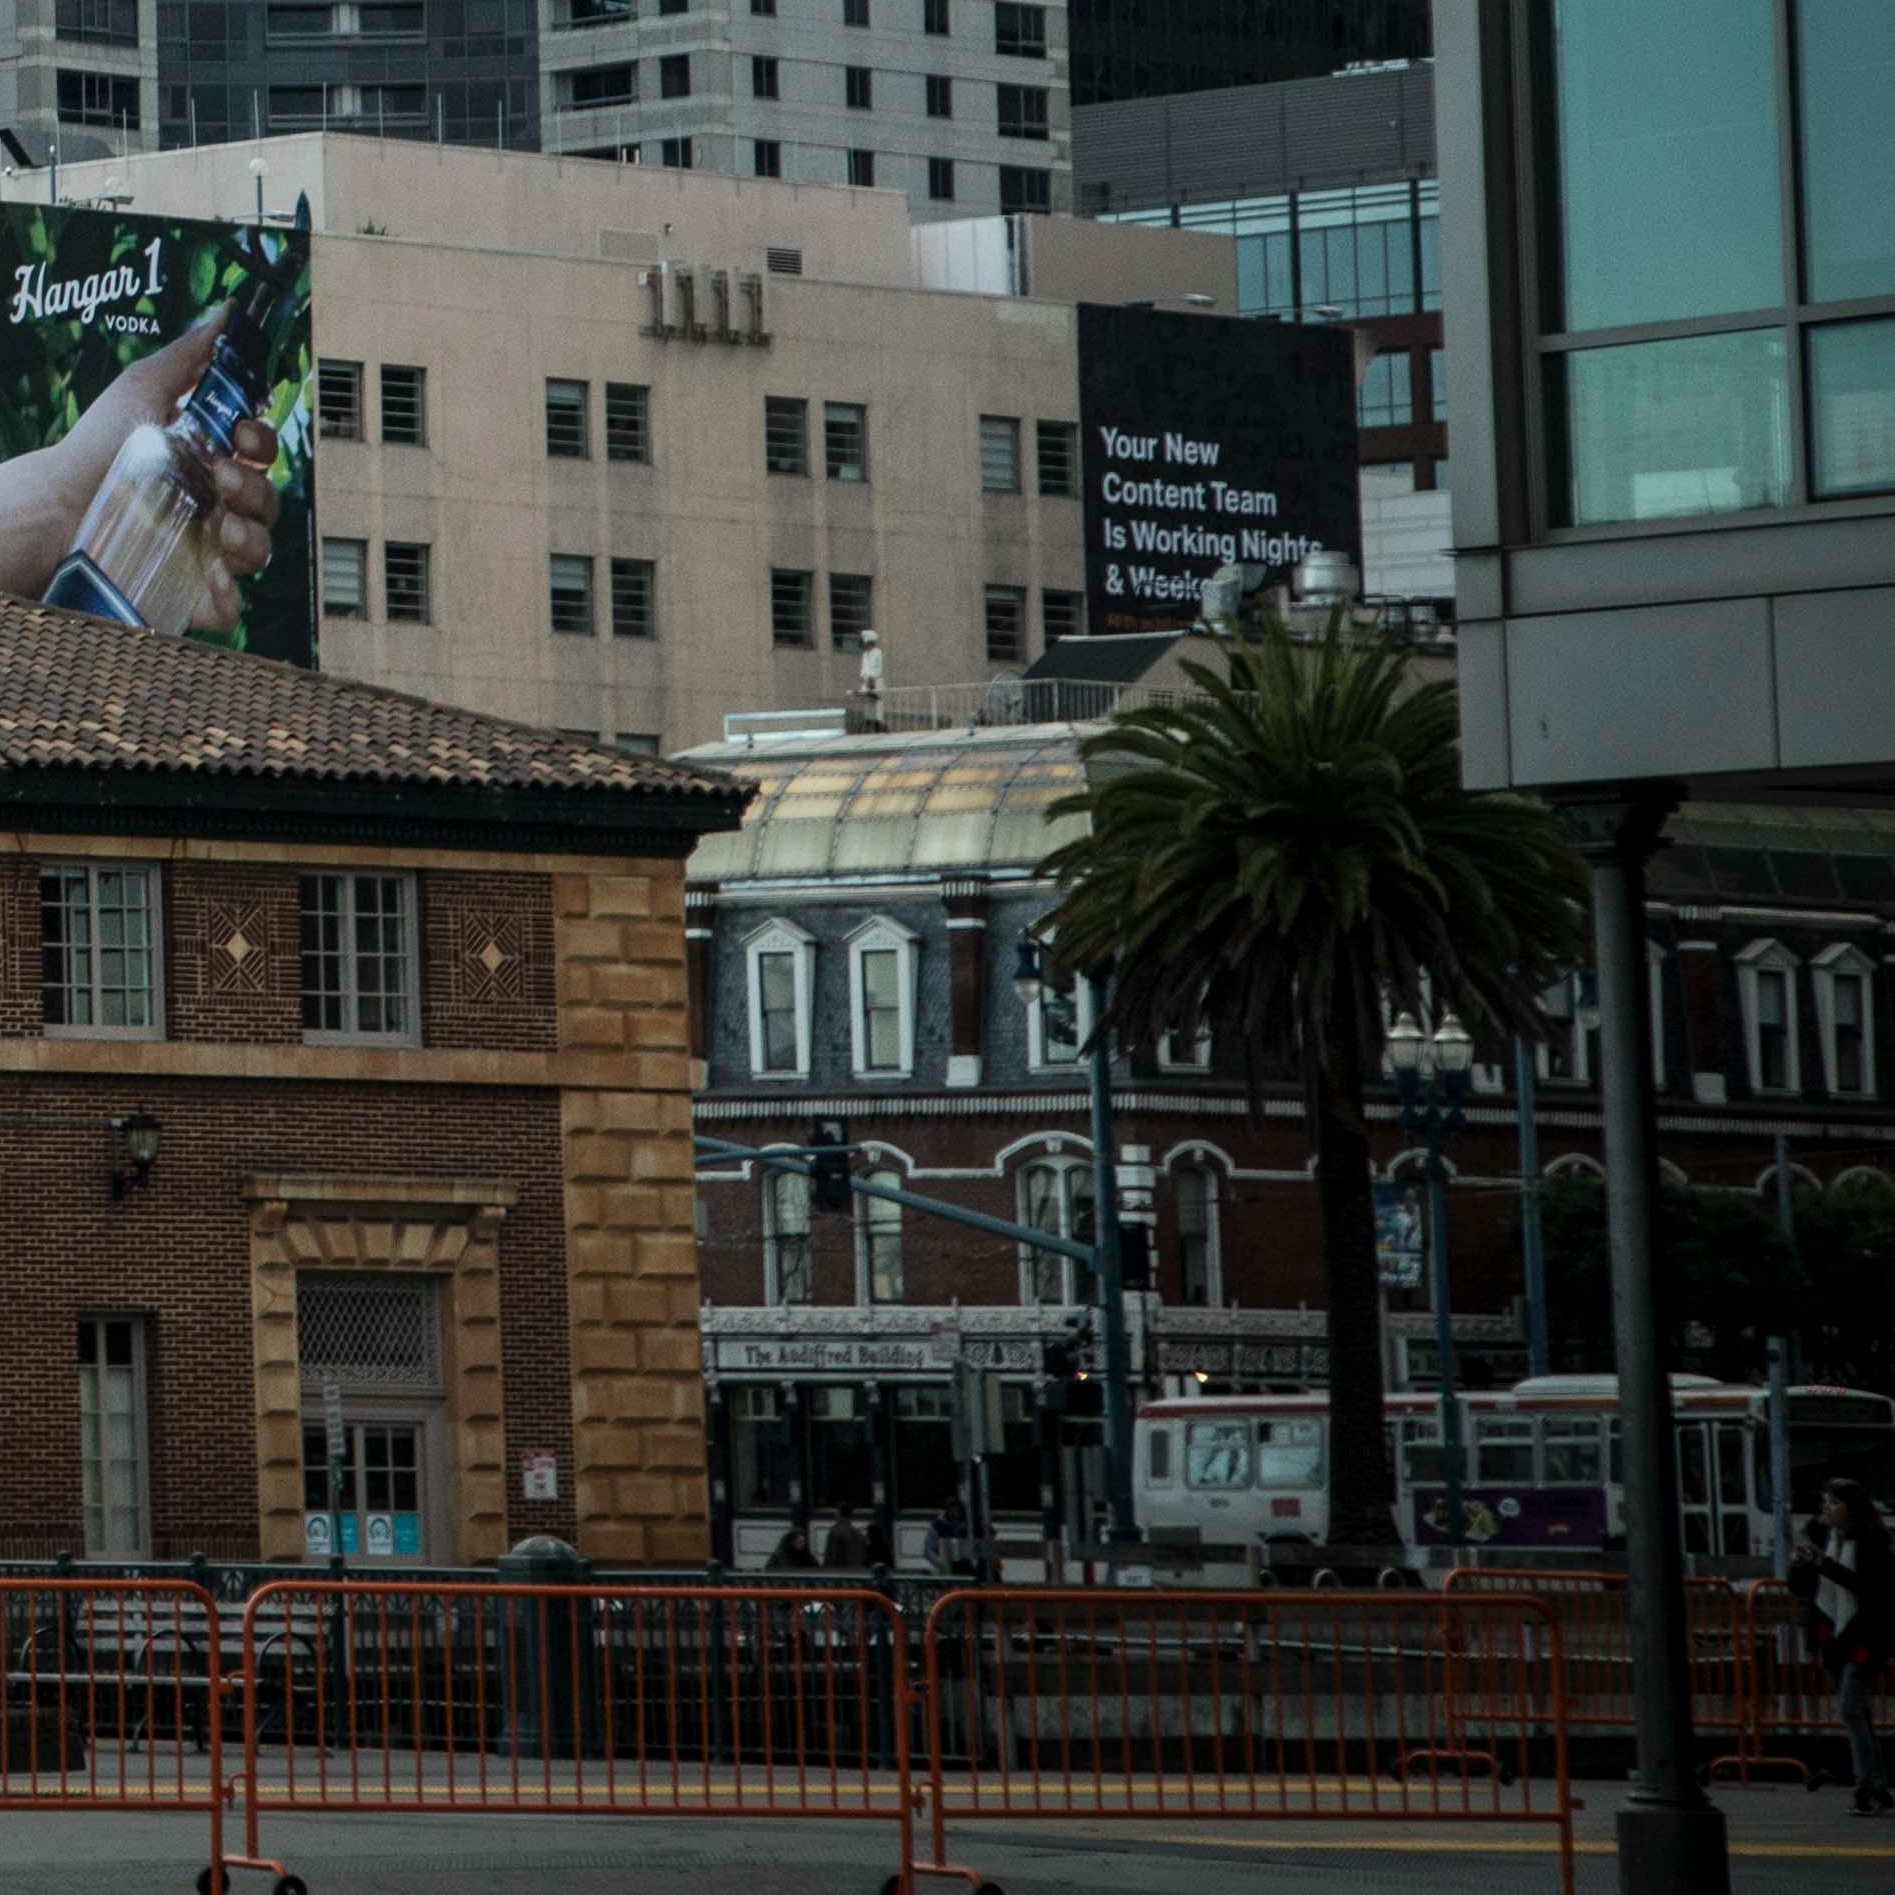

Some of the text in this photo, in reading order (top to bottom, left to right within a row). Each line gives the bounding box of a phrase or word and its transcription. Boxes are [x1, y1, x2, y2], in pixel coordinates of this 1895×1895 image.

[9, 236, 164, 325] Hangar 1
[105, 314, 161, 335] VODKA
[1099, 425, 1220, 467] Your New
[1102, 472, 1277, 516] Content Team
[1104, 518, 1126, 550] Is
[1131, 520, 1236, 565] Working
[1105, 563, 1209, 601] & Week
